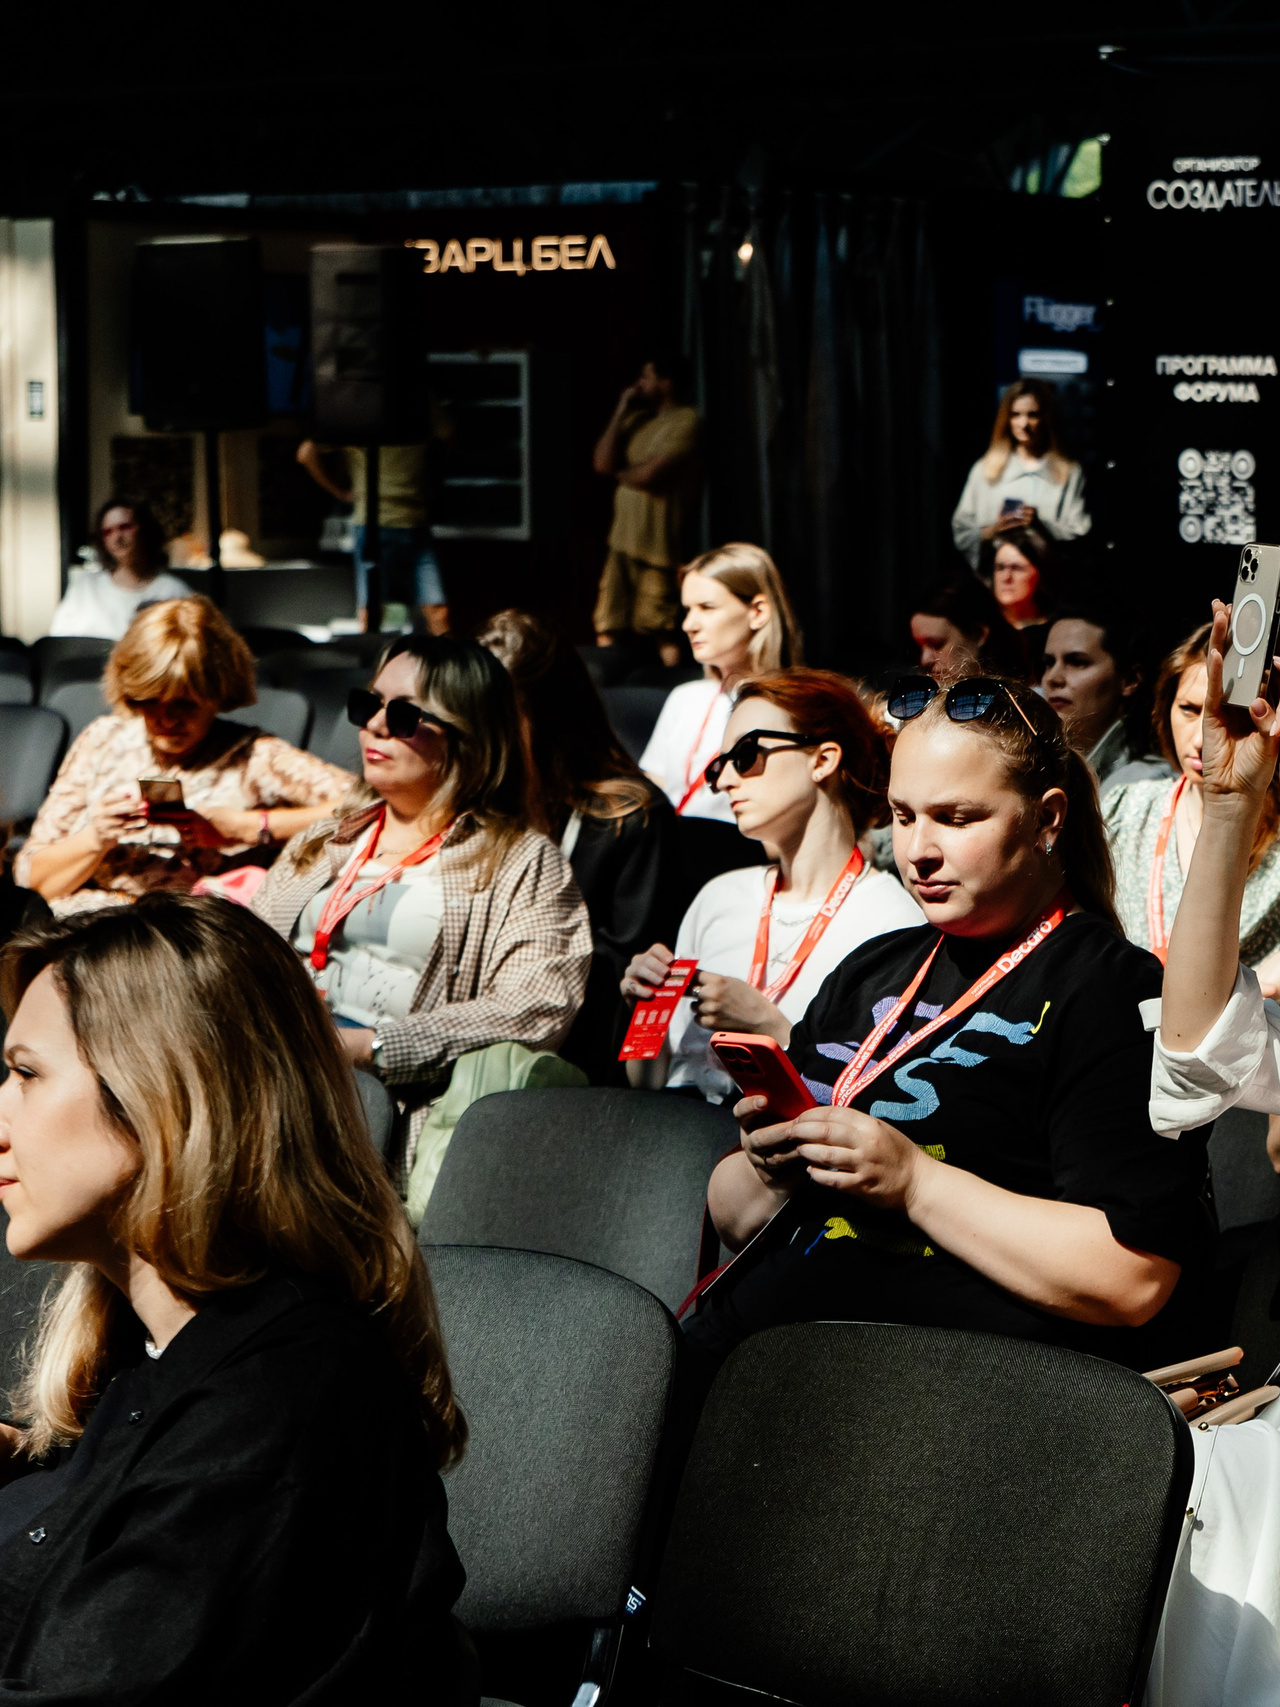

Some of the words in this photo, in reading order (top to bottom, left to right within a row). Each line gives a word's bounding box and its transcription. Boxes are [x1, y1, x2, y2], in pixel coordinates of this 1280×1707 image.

[1173, 156, 1261, 173] ОРГАНИЗАТОР
[1156, 355, 1278, 376] ПРОГРАММА
[1173, 381, 1260, 402] ФОРУМА
[820, 873, 857, 918] Decaro
[996, 920, 1053, 974] Decaro
[837, 1060, 889, 1107] ЕЛОРУССКИЕ
